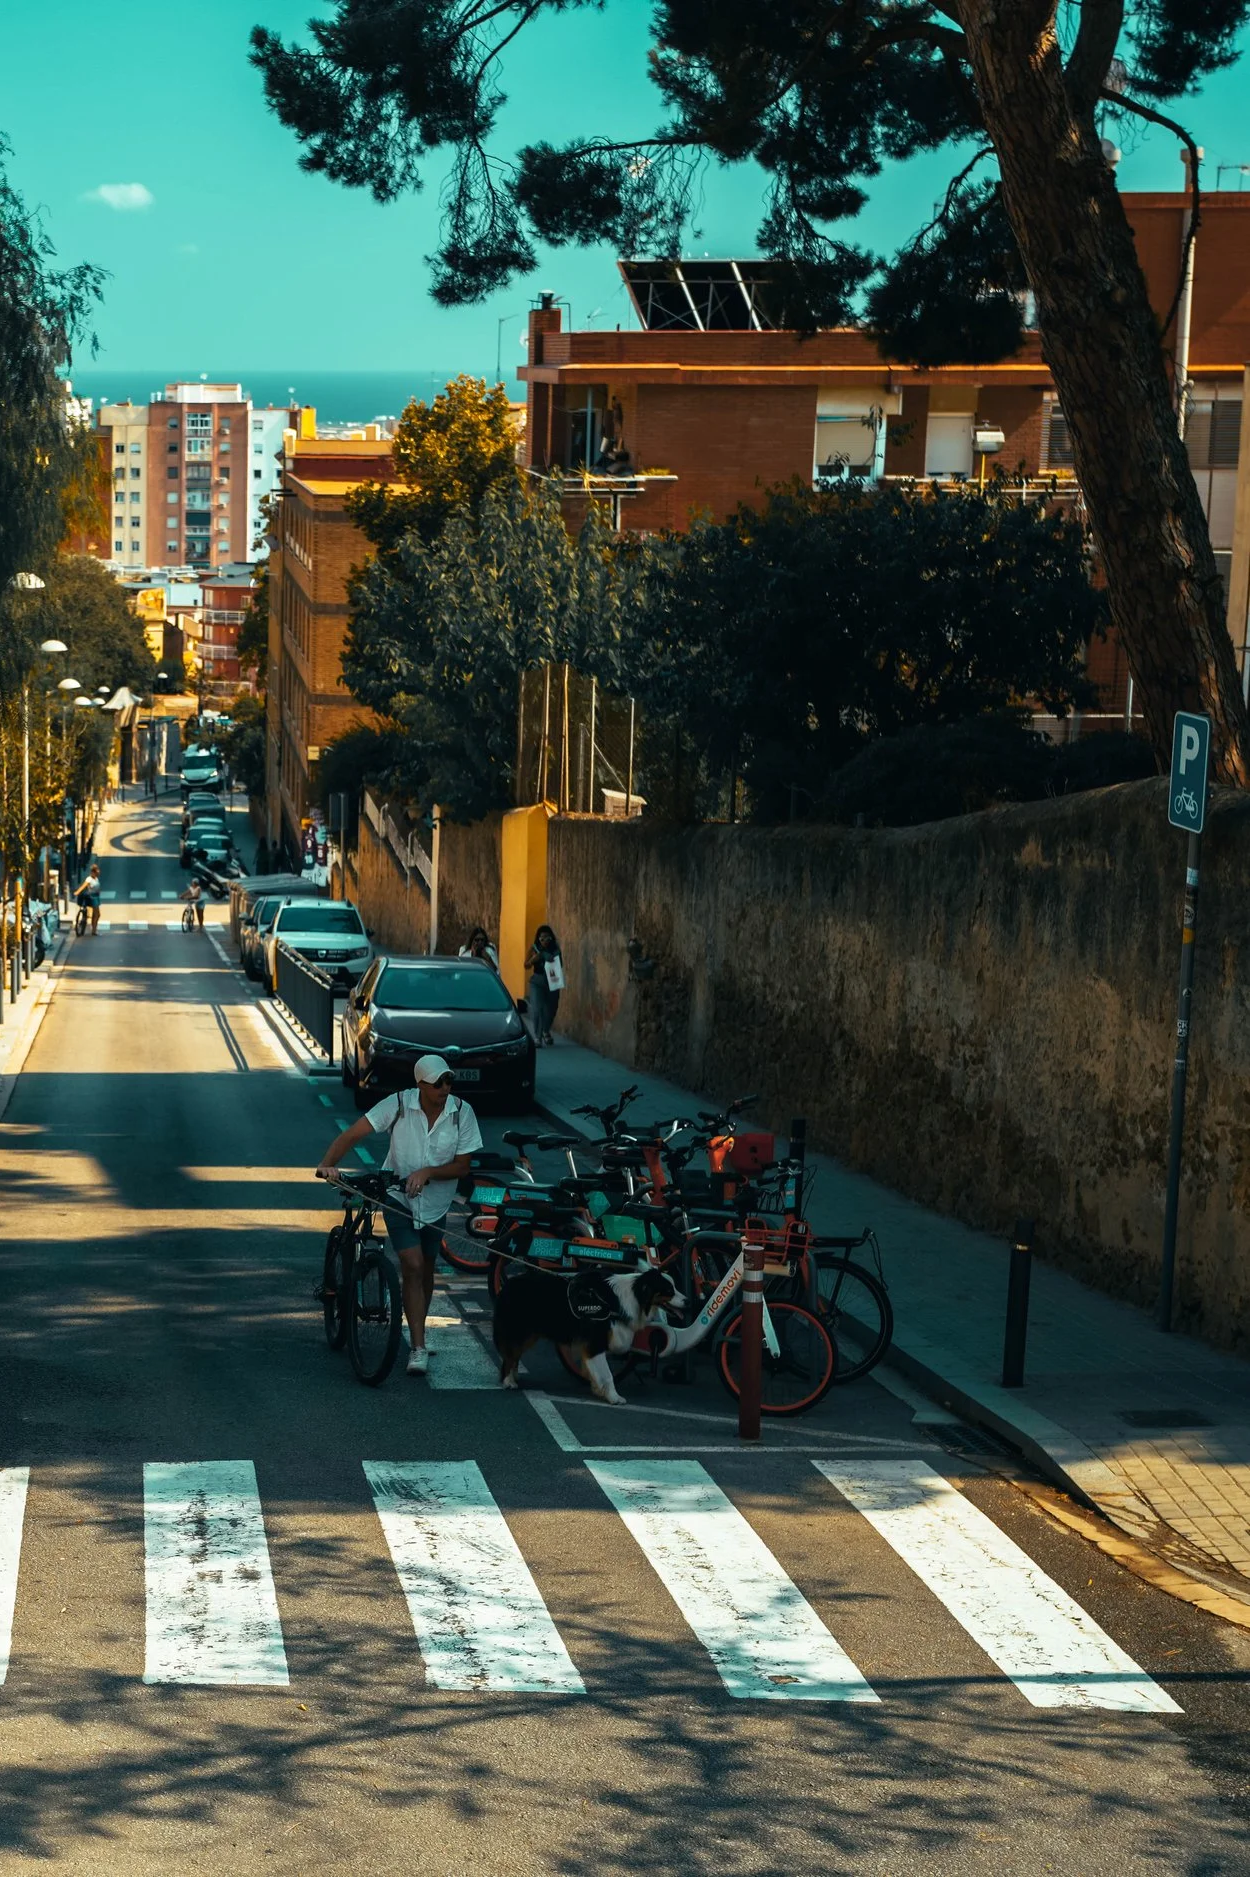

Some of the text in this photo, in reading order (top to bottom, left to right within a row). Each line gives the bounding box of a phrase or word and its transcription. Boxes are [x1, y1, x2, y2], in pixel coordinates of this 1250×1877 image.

[1179, 724, 1200, 775] P
[475, 1187, 495, 1195] BEST
[477, 1194, 501, 1203] PRICE
[533, 1239, 555, 1248] BEST
[535, 1247, 560, 1256] PRICE
[579, 1248, 612, 1258] eléctrica
[707, 1268, 741, 1317] ridemovi
